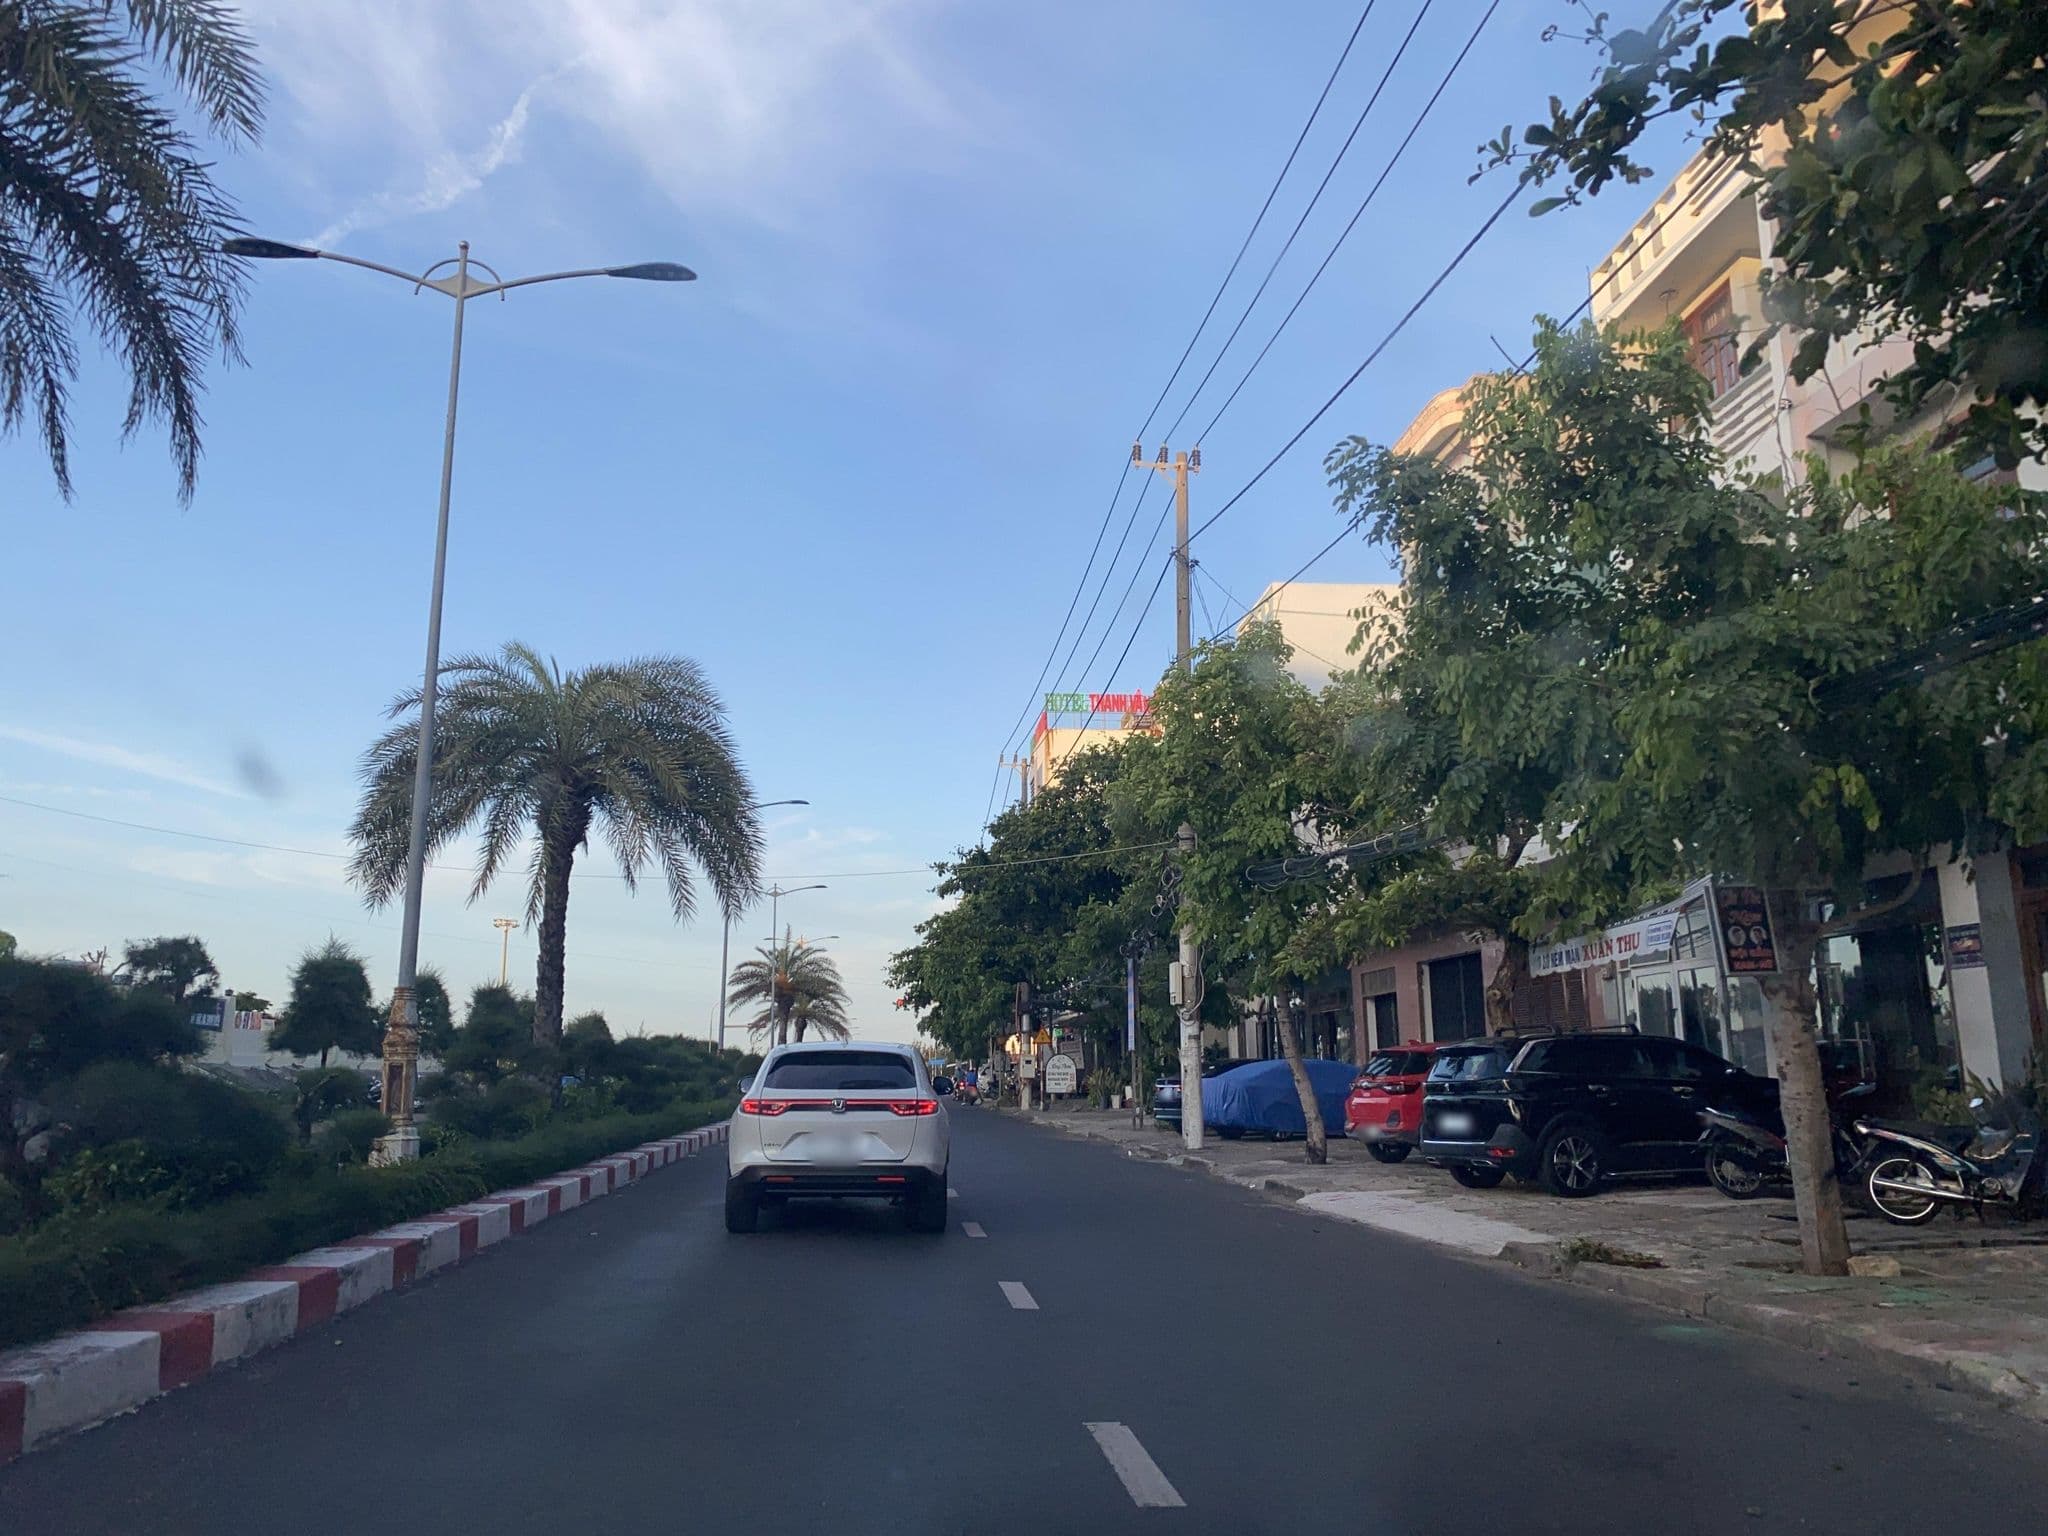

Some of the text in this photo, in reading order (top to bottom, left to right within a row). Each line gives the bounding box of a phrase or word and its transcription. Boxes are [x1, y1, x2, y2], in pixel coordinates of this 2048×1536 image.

[1045, 693, 1088, 711] HOTEL
[1089, 693, 1126, 712] THANH
[1616, 931, 1640, 953] THU
